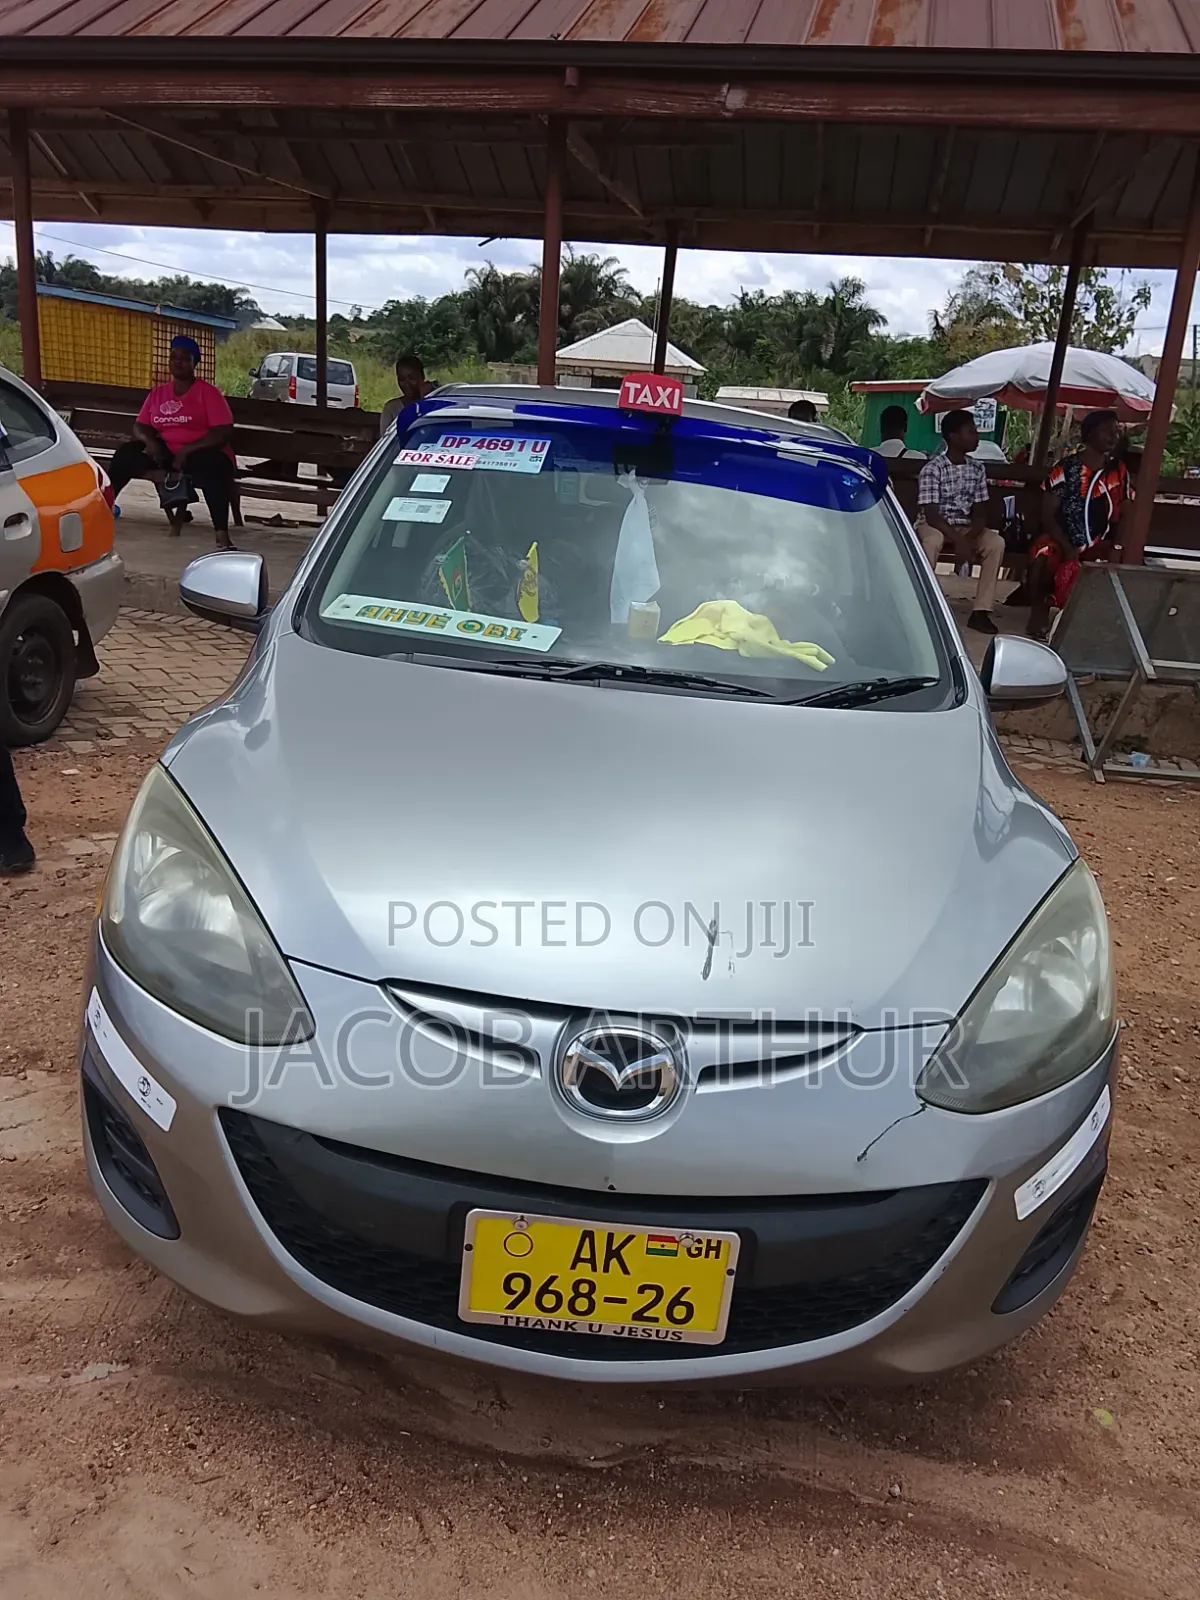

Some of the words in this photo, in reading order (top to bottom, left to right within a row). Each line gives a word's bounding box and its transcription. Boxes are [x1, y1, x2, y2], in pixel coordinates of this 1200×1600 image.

[624, 381, 681, 410] TAXI
[441, 436, 472, 449] DP
[531, 440, 547, 453] U
[401, 452, 433, 463] FOR
[434, 454, 475, 466] SALE
[456, 619, 528, 642] OBI
[569, 1229, 636, 1276] AK
[685, 1238, 723, 1259] GH
[502, 1272, 695, 1325] 968-26
[500, 1315, 578, 1332] THANK
[588, 1323, 603, 1333] U
[613, 1325, 683, 1341] JESUS
